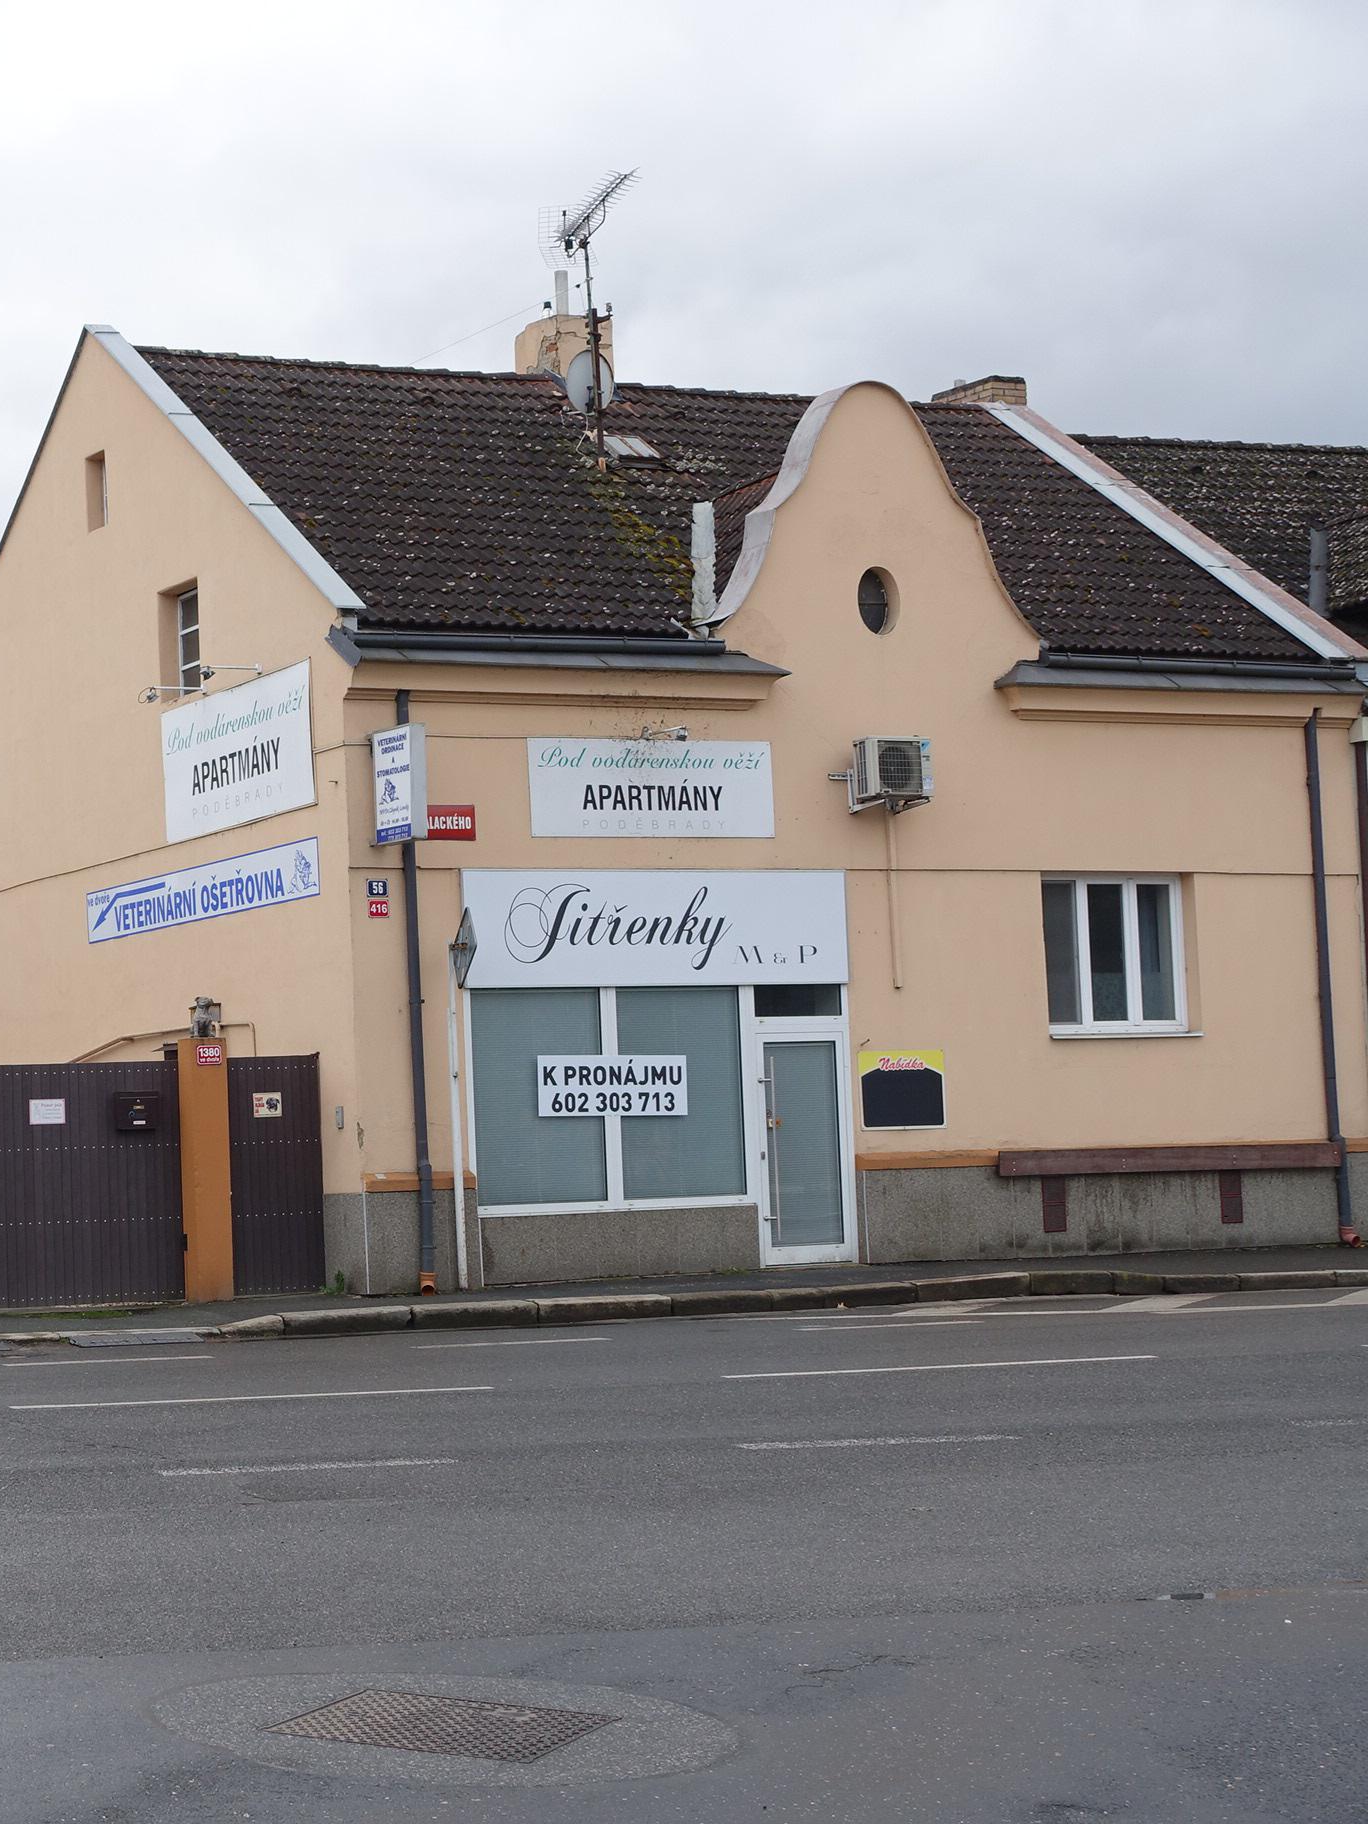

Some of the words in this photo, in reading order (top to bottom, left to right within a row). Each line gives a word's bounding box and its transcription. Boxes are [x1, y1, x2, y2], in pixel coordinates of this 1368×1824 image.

[166, 722, 194, 755] Pod
[196, 700, 274, 743] vodárenskou
[278, 684, 305, 715] věží
[377, 733, 407, 747] VETERINÁRNÍ
[381, 743, 404, 754] ORDINACE
[192, 736, 280, 796] APARTMÁNY
[538, 745, 587, 769] Pod
[591, 747, 715, 770] vodárenskou
[723, 751, 765, 770] věží
[377, 764, 410, 778] STOMATOLOGIE
[192, 783, 283, 818] PODĚBRADY
[583, 779, 723, 811] APARTMÁNY
[428, 813, 472, 829] LACKÉHO
[583, 817, 725, 830] PODĚBRADY
[372, 882, 383, 893] 56
[114, 881, 197, 932] VETERINÁRNÍ
[201, 868, 285, 914] OŠETŘOVNA
[370, 904, 387, 913] 416
[504, 883, 733, 970] Jitřenky
[733, 945, 765, 964] M
[799, 945, 818, 964] P
[199, 1047, 220, 1057] 1380
[543, 1066, 557, 1085] K
[564, 1059, 682, 1085] PRONÁJMU
[878, 1057, 925, 1070] Nabídka
[551, 1092, 589, 1113] 602
[595, 1092, 632, 1113] 303
[638, 1092, 675, 1112] 713
